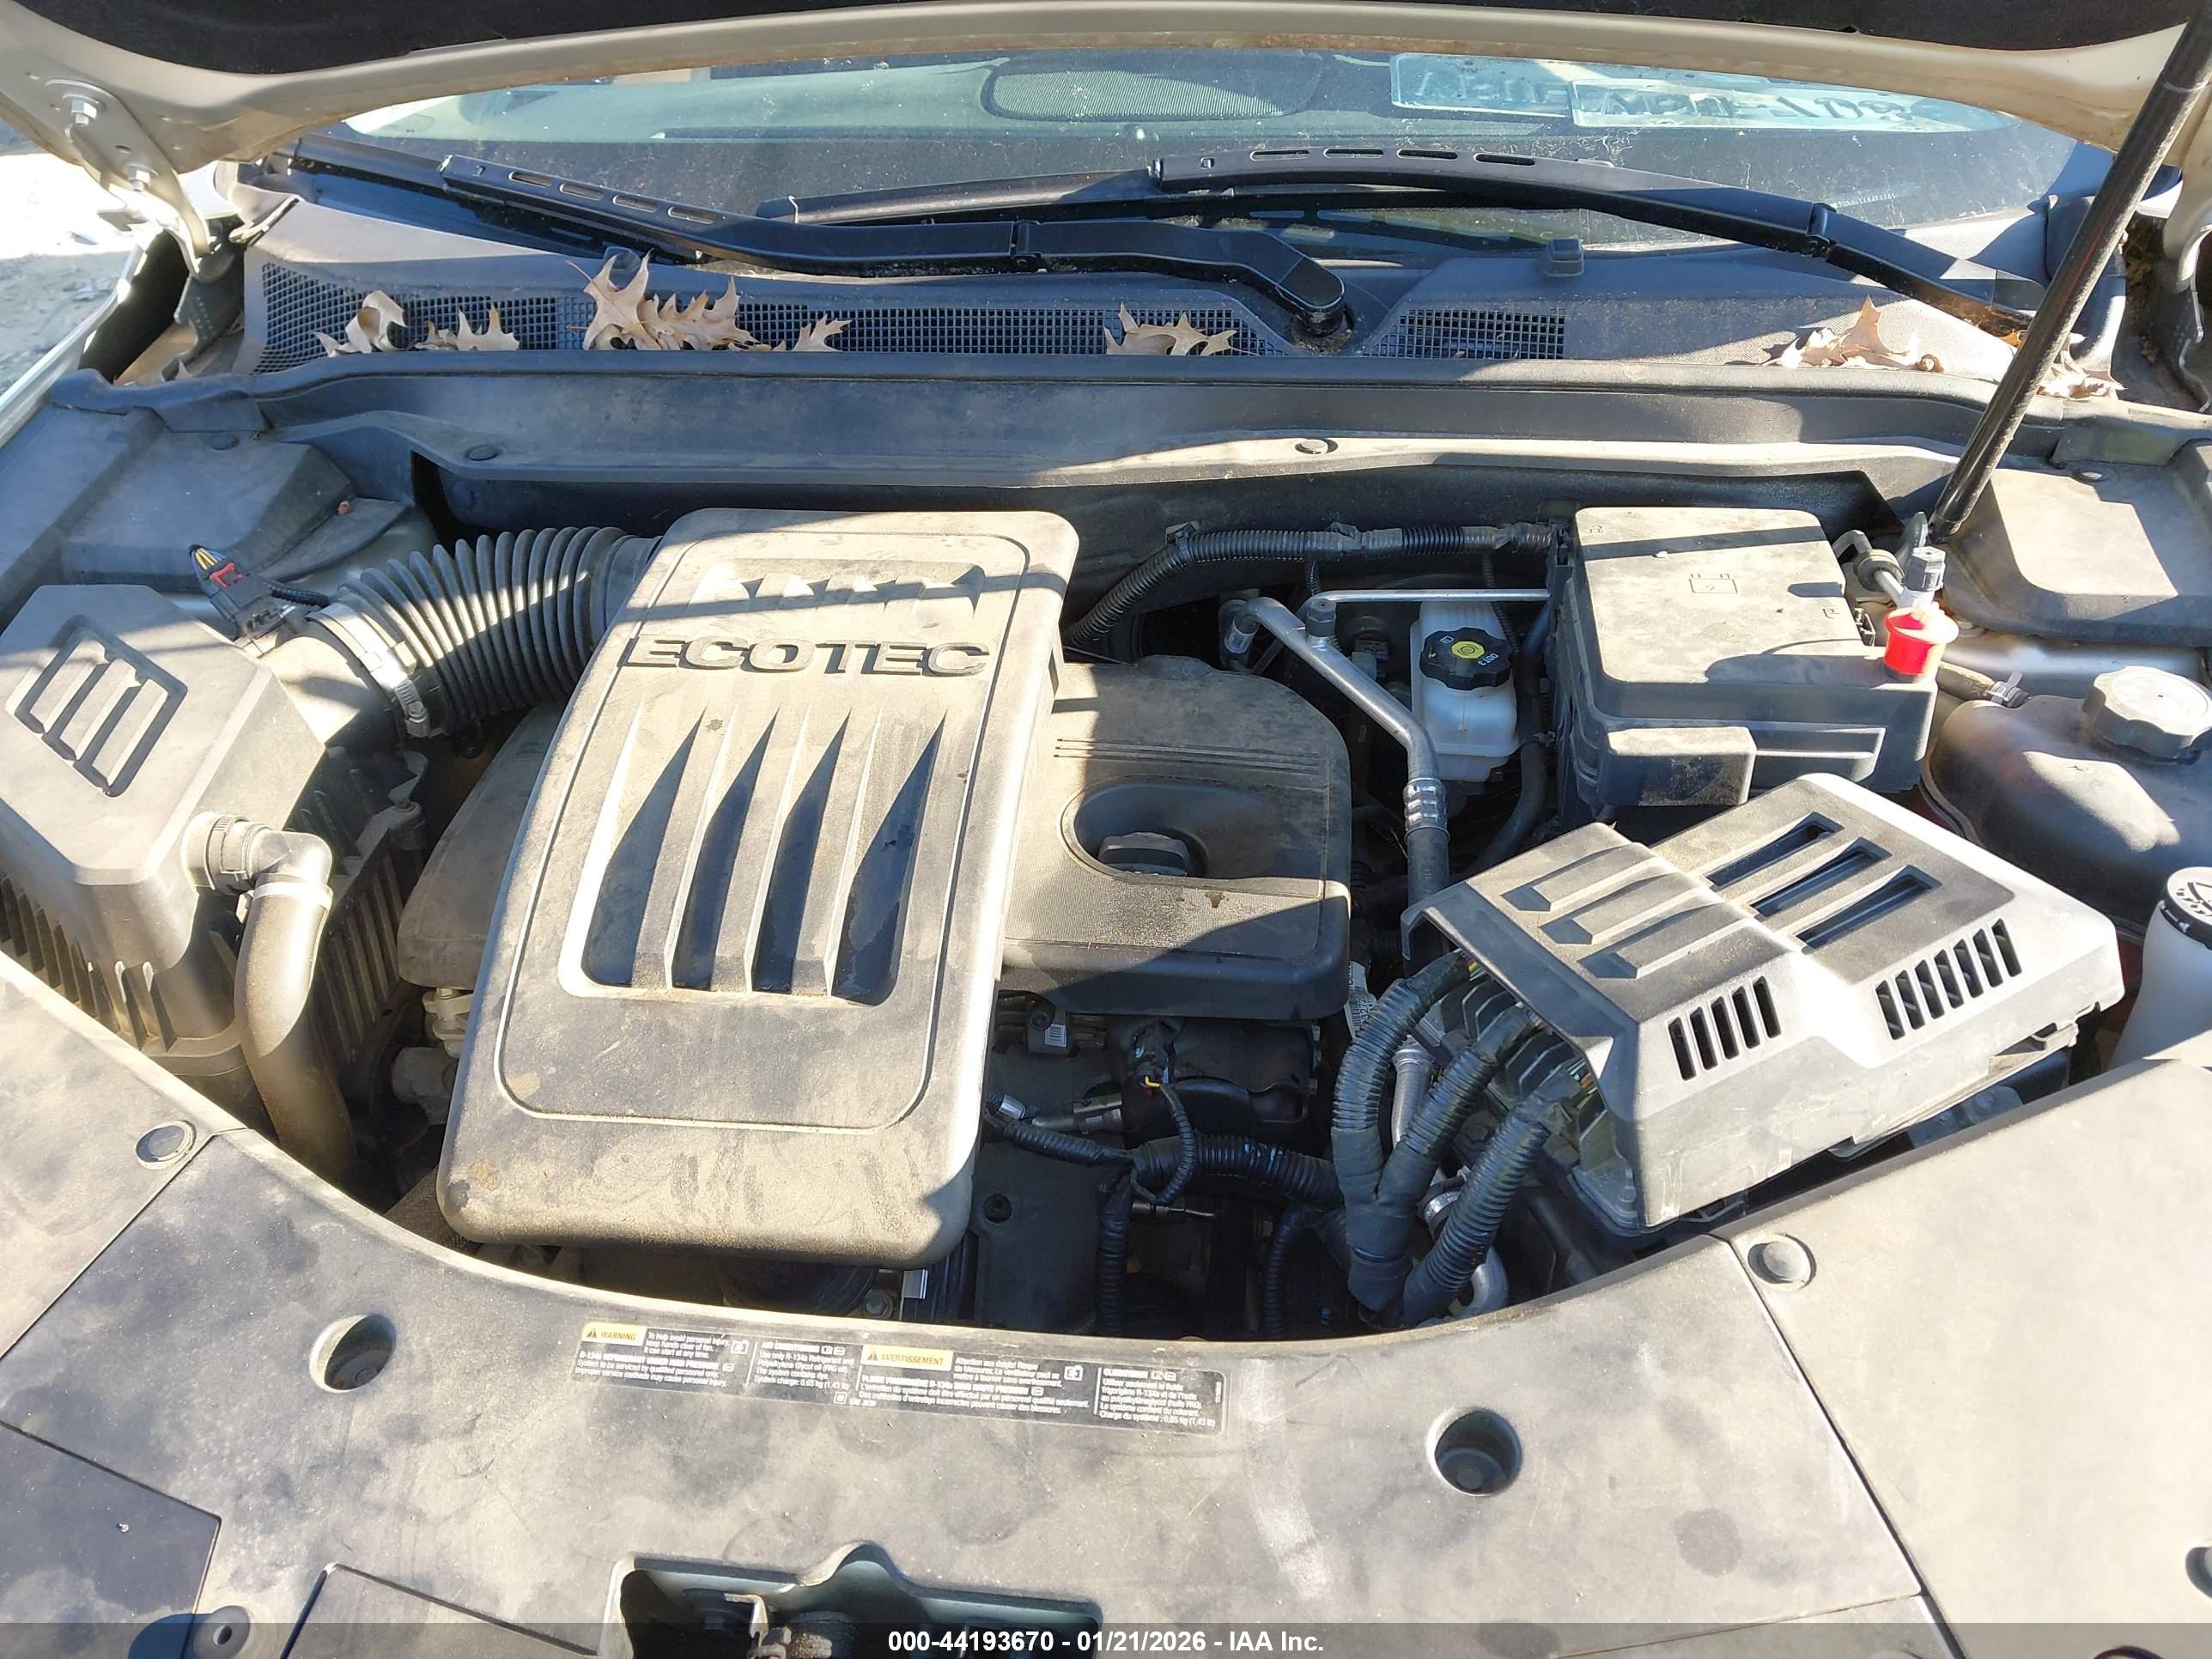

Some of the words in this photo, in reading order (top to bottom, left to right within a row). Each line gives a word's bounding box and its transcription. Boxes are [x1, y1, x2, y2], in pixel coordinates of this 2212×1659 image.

[624, 634, 990, 677] ECOTEC
[600, 1331, 636, 1340] WARNING
[686, 1336, 712, 1345] personal
[785, 1352, 808, 1361] R-134a
[809, 1355, 842, 1364] Refrigerant
[881, 1353, 944, 1365] AVERTISSEMENT
[956, 1358, 982, 1366] Attention
[577, 1359, 599, 1368] System
[649, 1366, 676, 1375] qualified
[676, 1368, 705, 1377] personnel
[794, 1363, 813, 1371] Glycol
[768, 1369, 790, 1377] system
[682, 1377, 708, 1386] personal
[1099, 1411, 1122, 1419] Charge
